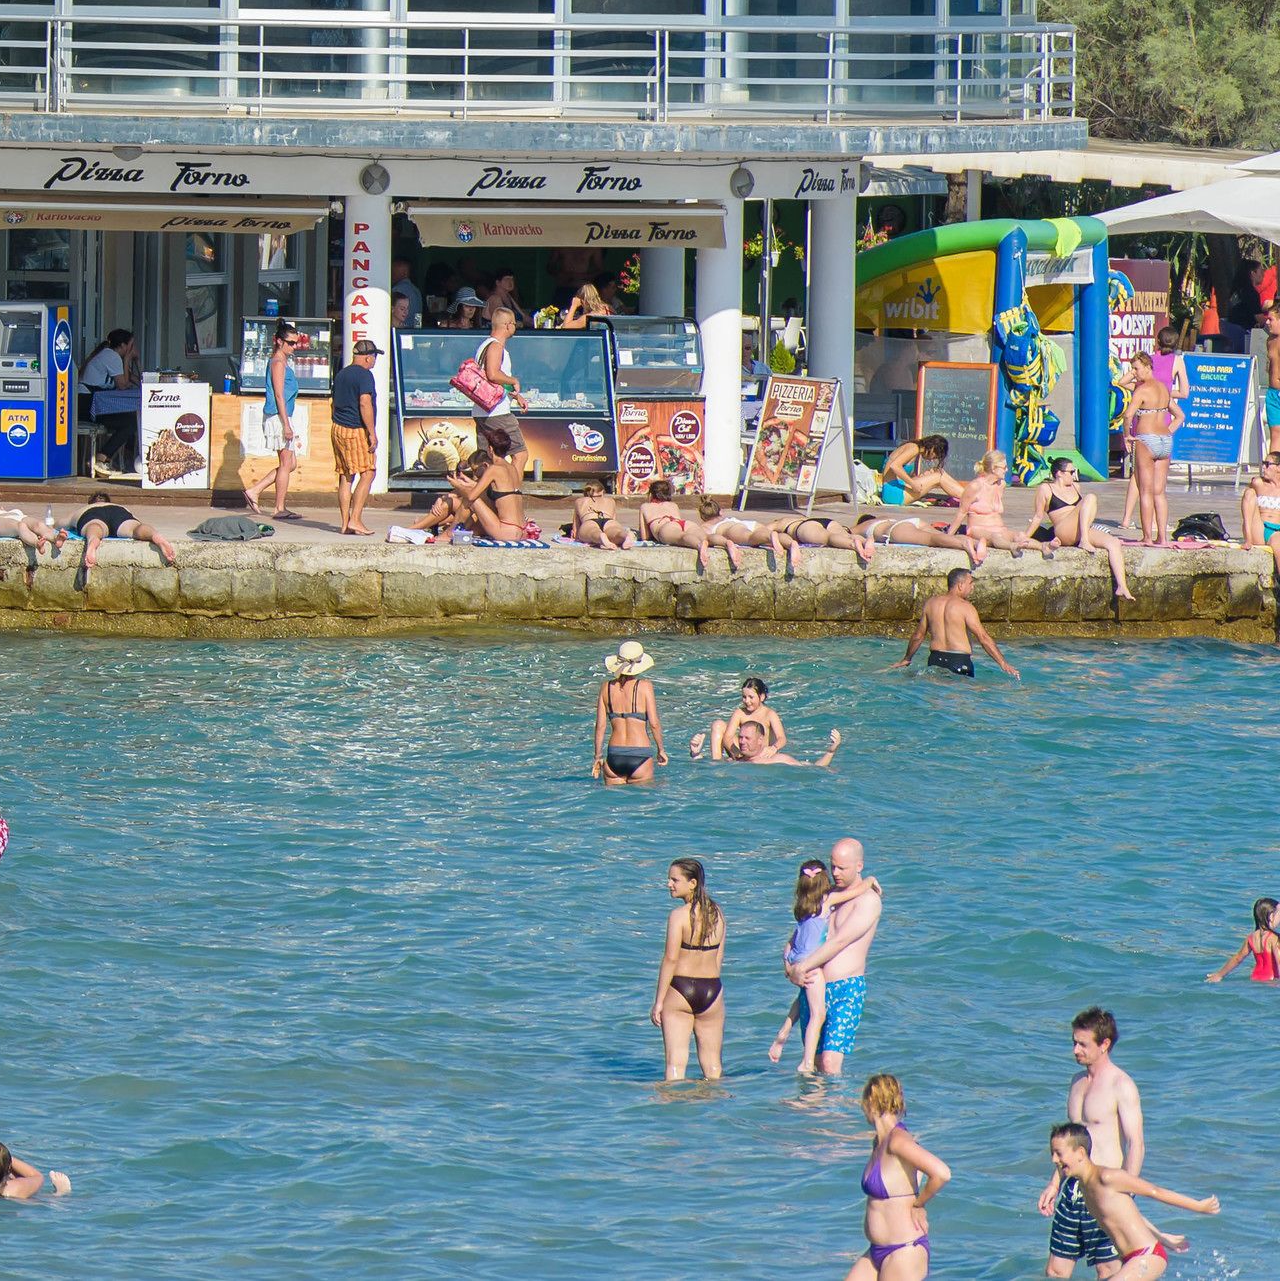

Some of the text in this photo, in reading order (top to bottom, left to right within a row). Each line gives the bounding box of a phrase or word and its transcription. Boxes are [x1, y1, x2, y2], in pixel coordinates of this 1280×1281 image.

[43, 156, 251, 192] Pizza Forno
[466, 165, 643, 197] Pizza Forno
[794, 168, 836, 199] Pizza
[160, 216, 228, 229] Pizza
[584, 221, 643, 245] Pizza
[645, 221, 698, 242] Forno
[883, 295, 941, 320] wibit
[148, 389, 182, 403] Forno
[772, 384, 815, 402] PIZZERIA
[571, 454, 608, 463] Grandissimo
